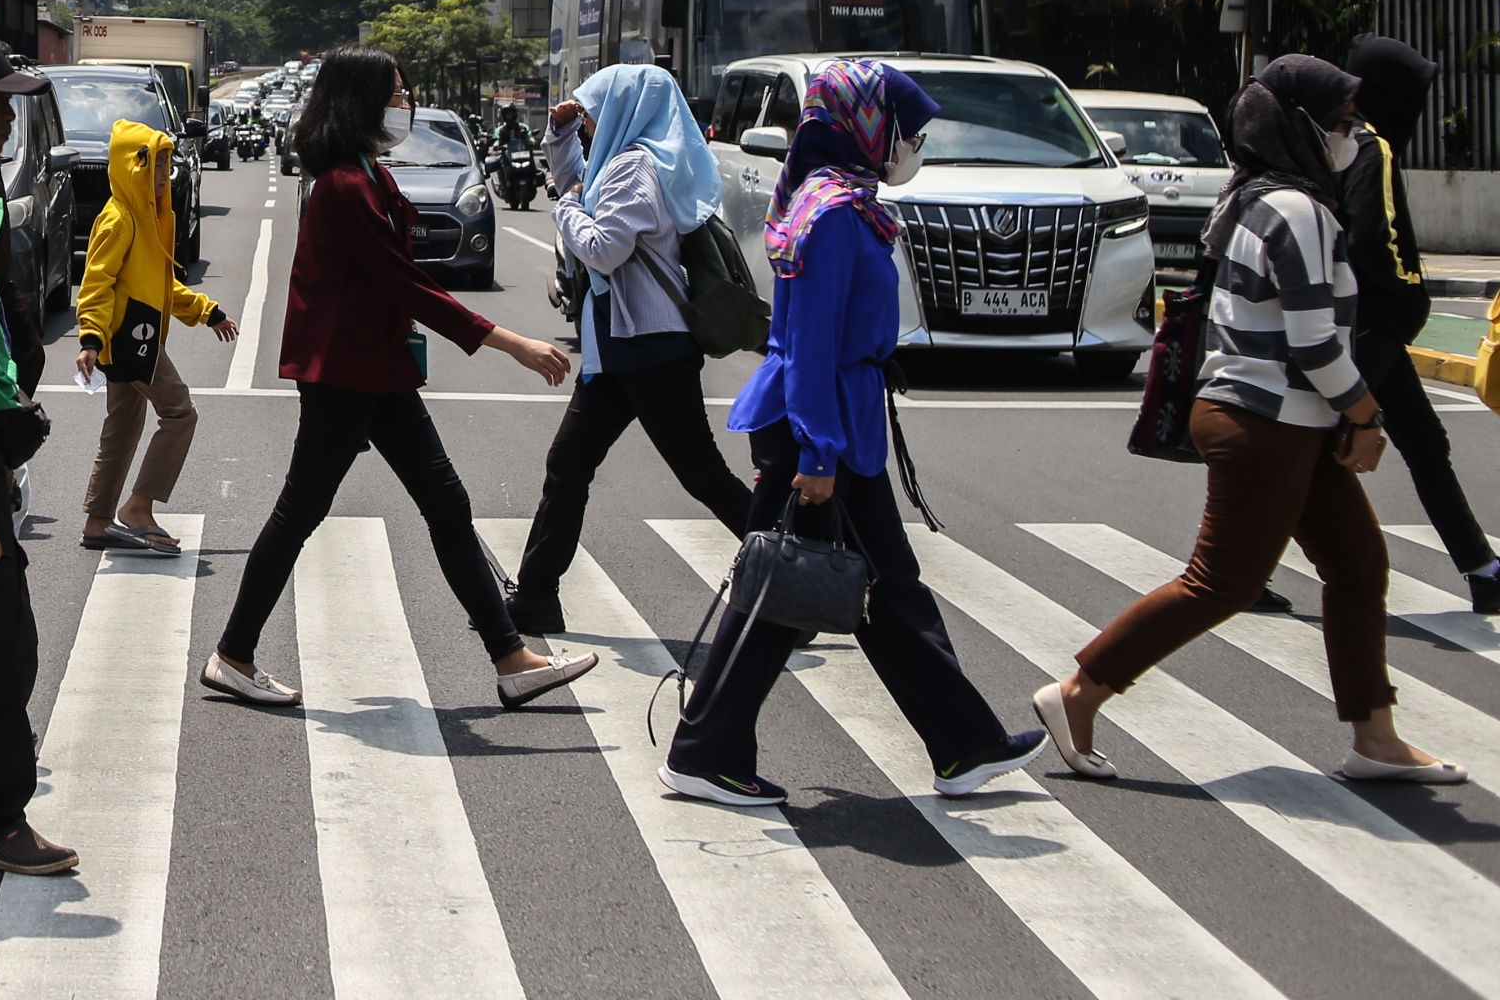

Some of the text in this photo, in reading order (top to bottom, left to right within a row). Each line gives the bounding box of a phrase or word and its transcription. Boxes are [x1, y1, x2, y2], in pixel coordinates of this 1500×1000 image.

[831, 6, 884, 17] TNH ABANG
[963, 291, 1046, 308] B 444 ACA
